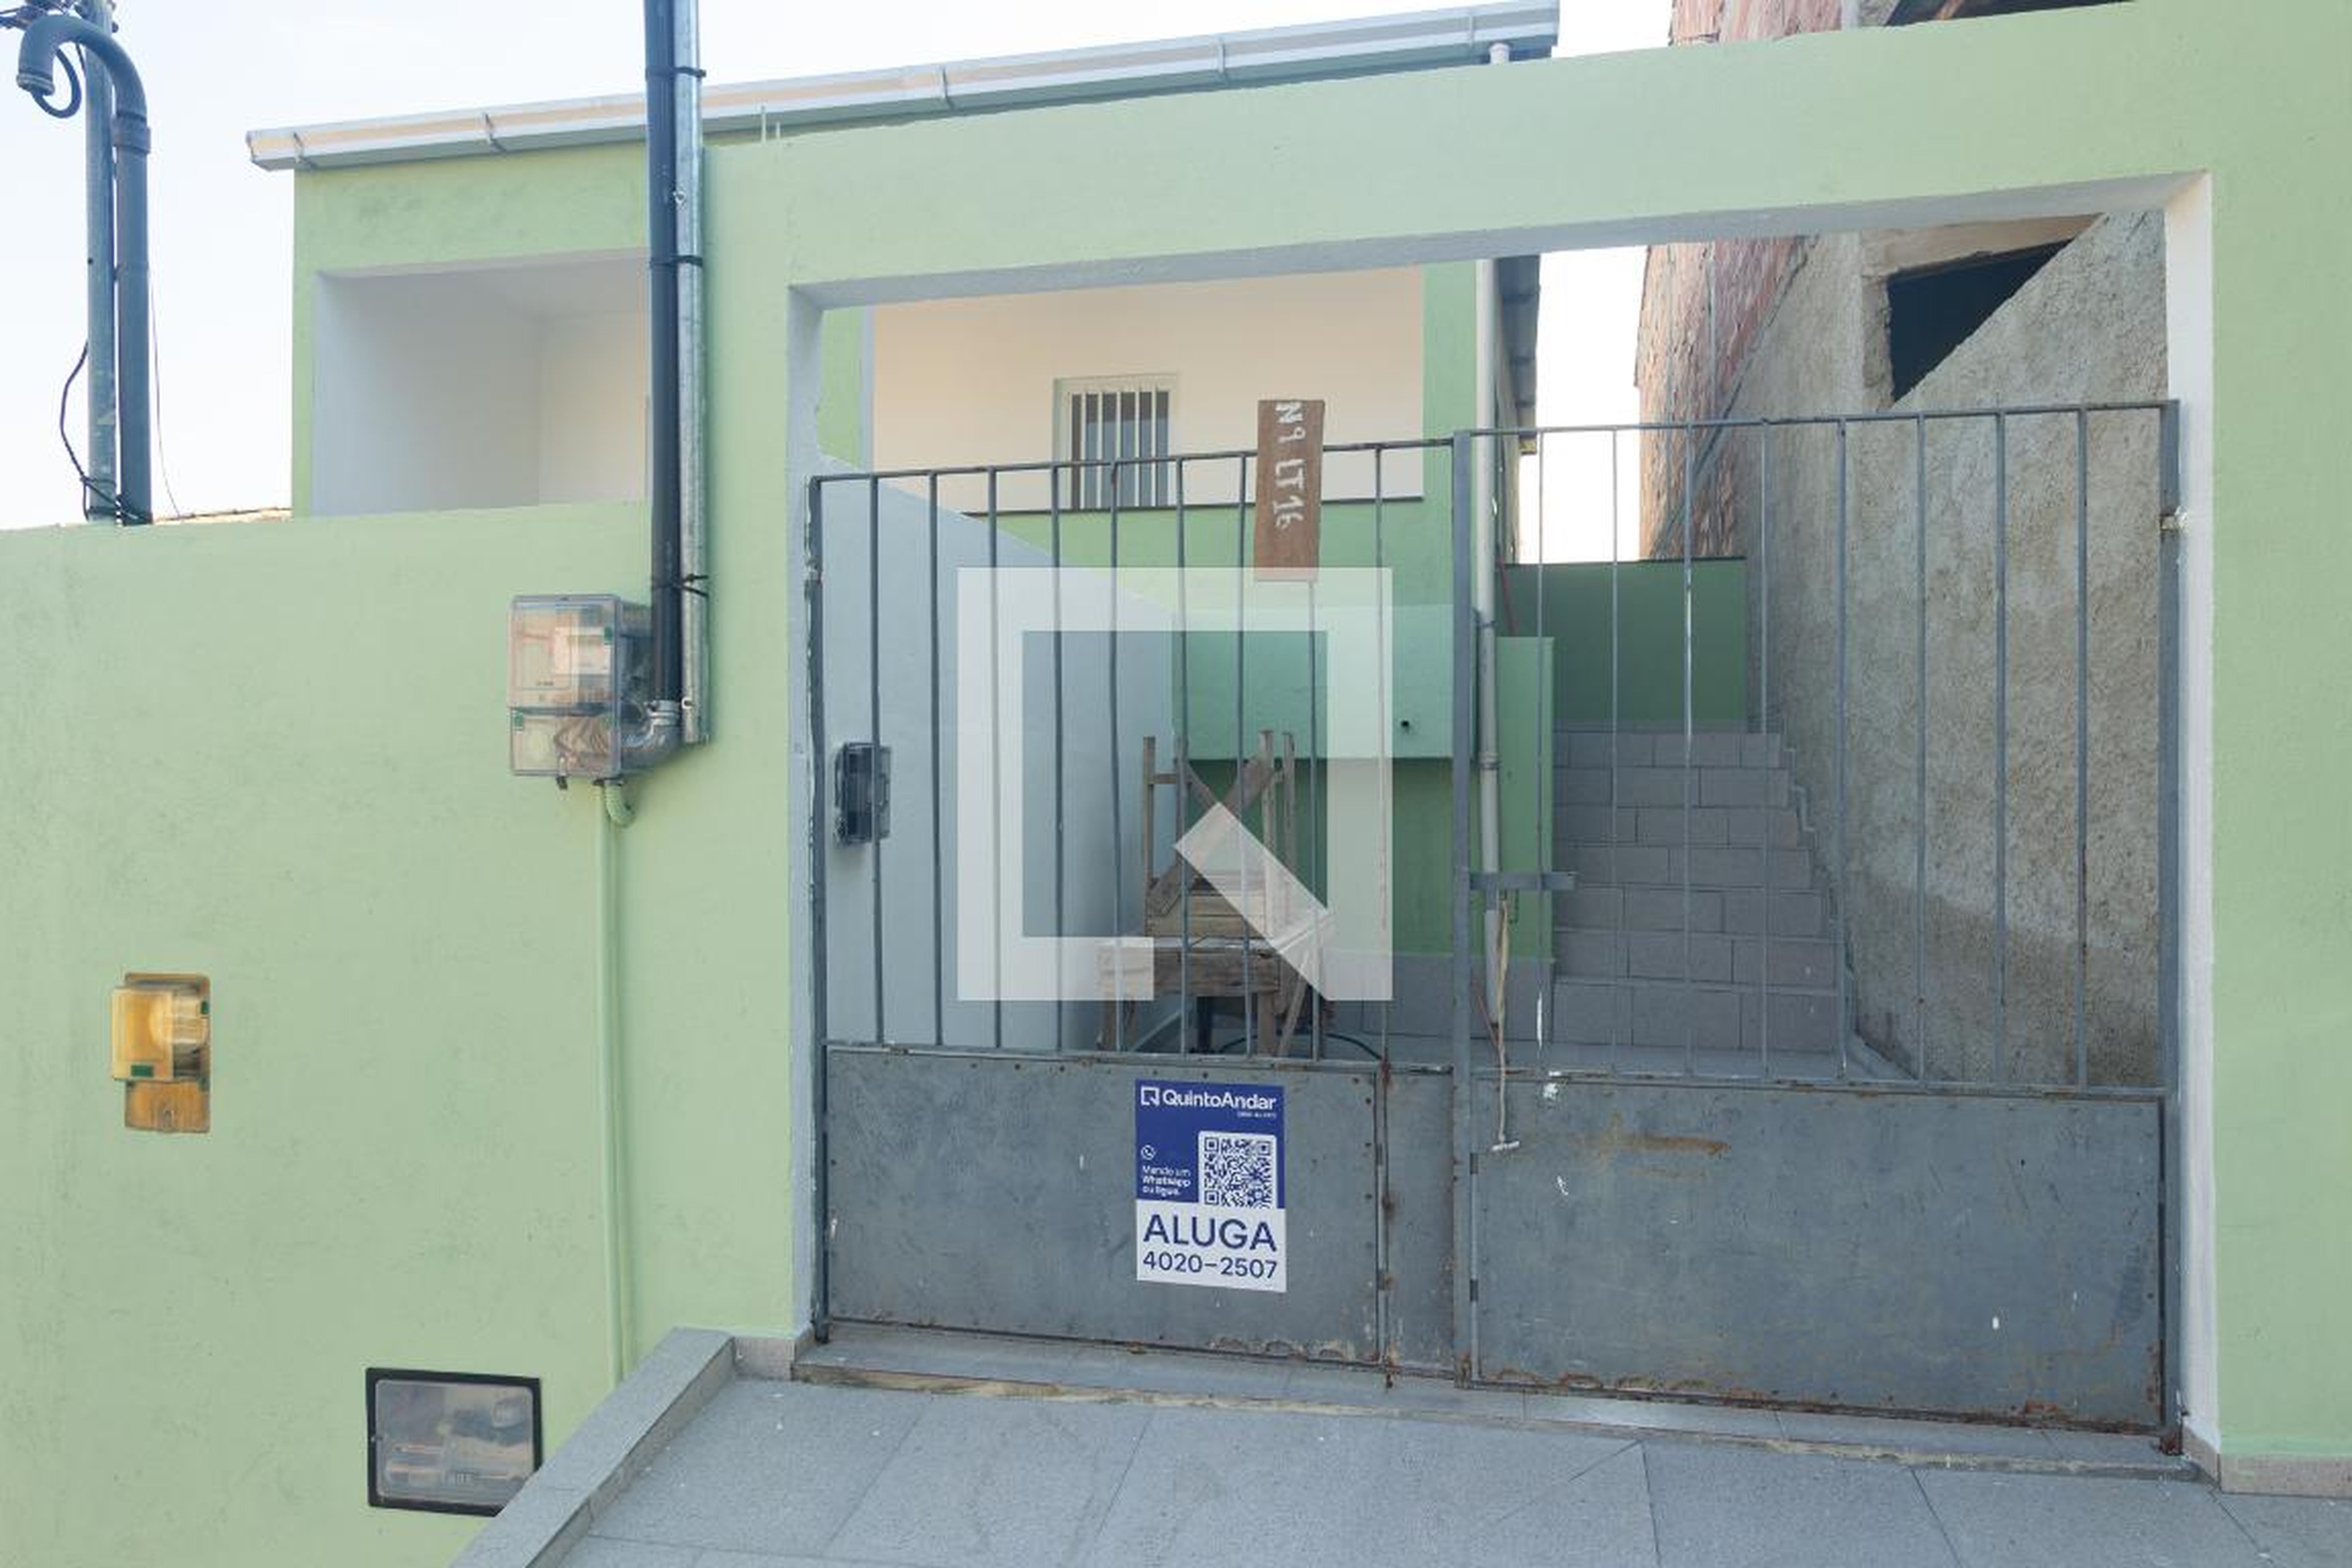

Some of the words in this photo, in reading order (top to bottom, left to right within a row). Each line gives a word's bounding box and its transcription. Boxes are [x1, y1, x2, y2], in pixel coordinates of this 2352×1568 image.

[1163, 1089, 1276, 1110] QuintoAndar
[1142, 1214, 1277, 1252] ALUGA
[1142, 1251, 1278, 1280] 4020-2507
